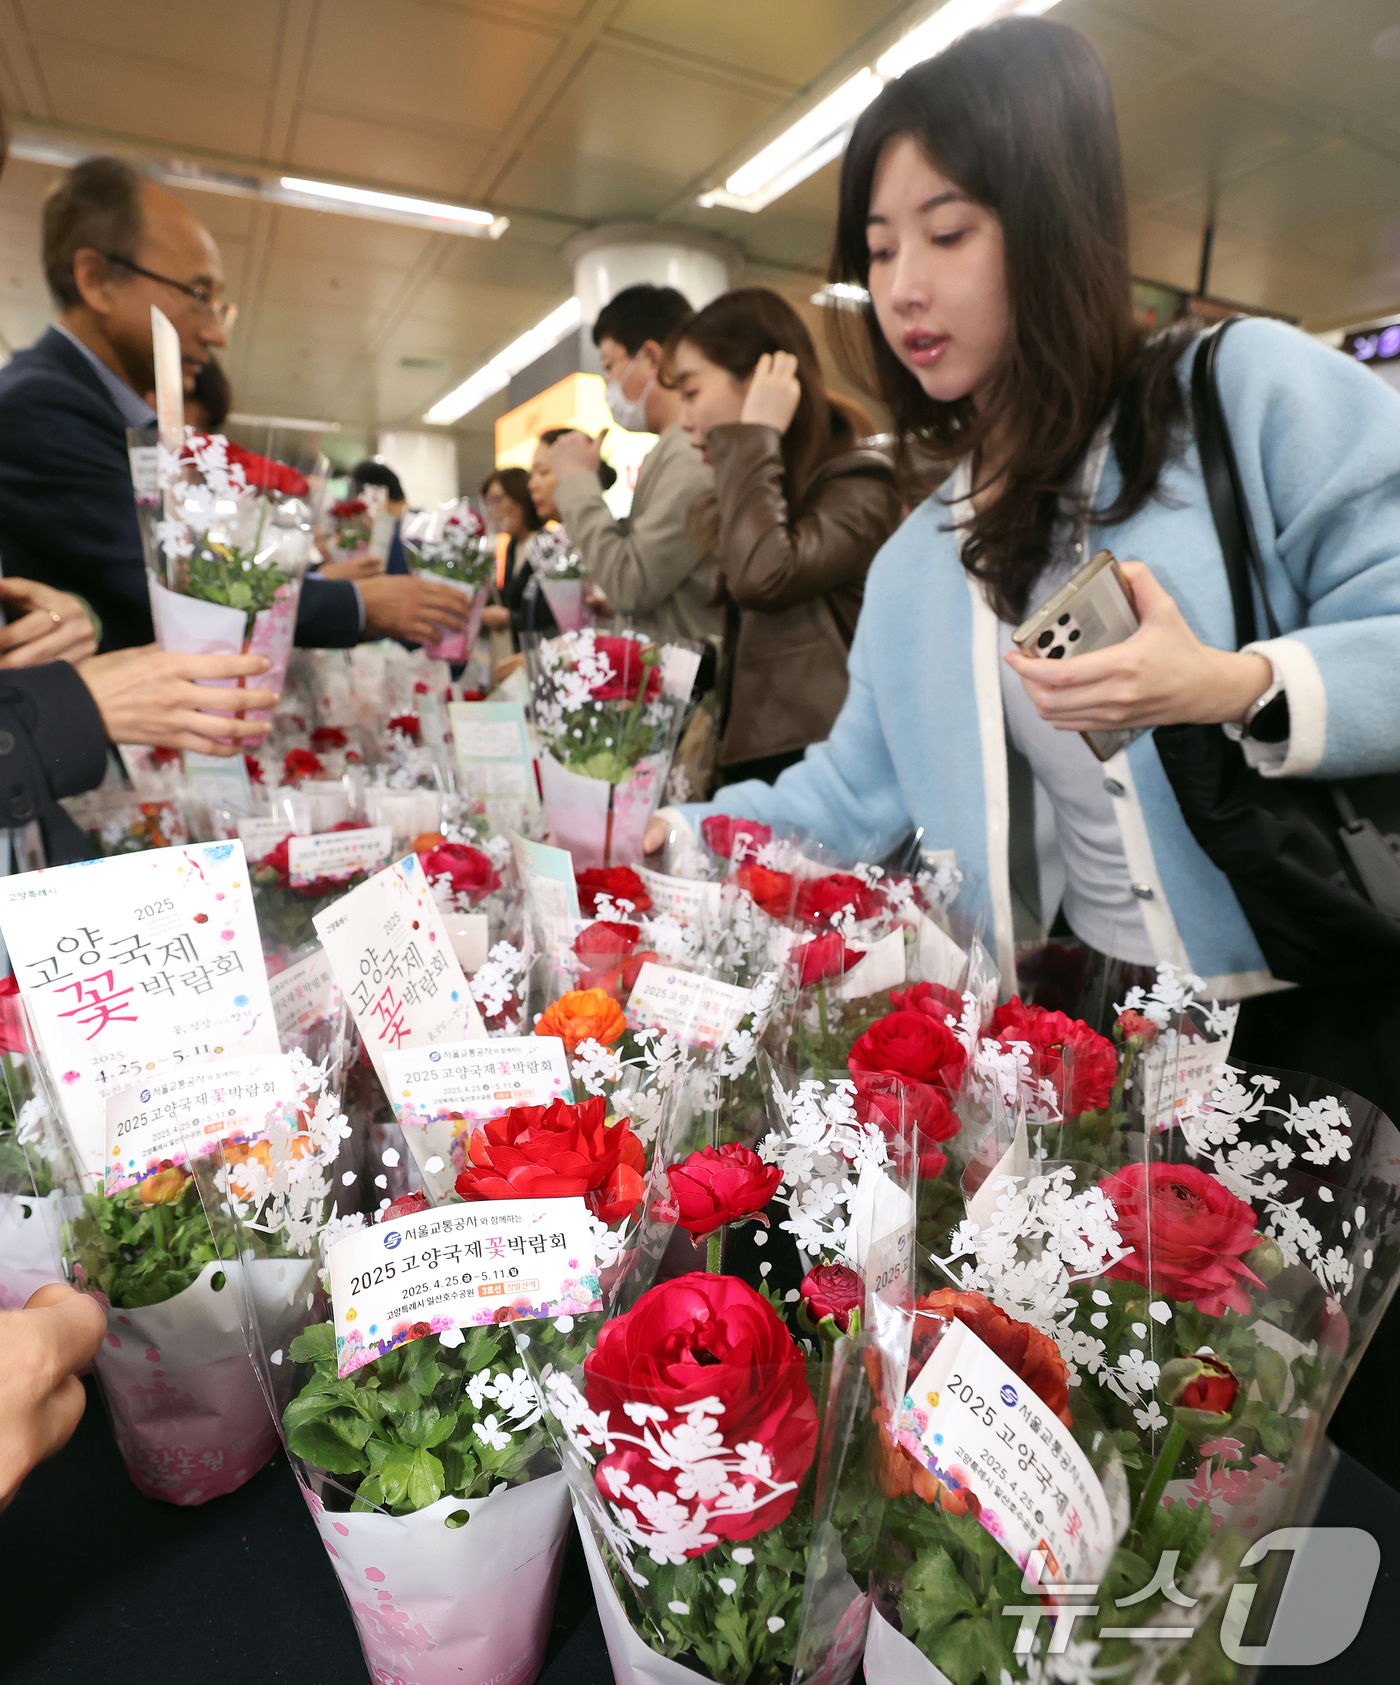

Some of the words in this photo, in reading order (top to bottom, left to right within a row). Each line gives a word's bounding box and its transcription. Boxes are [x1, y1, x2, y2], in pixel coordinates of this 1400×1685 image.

[8, 886, 58, 902] 고양특례시
[133, 897, 175, 922] 2025
[383, 911, 401, 936] 2025
[24, 926, 200, 989] 고양국제
[351, 941, 425, 1016] 고양국제
[53, 950, 245, 1041] 꽃박람회
[370, 949, 449, 1050] 꽃박람회
[404, 1069, 439, 1084] 2025
[441, 1060, 553, 1079] 고양국제꽃박람회
[443, 1046, 492, 1059] 서울교통공사
[152, 1073, 206, 1097] 서울교통공사
[117, 1112, 148, 1138] 2025
[151, 1081, 275, 1122] 고양국제꽃박람회
[405, 1216, 478, 1241] 서울교통공사
[480, 1217, 489, 1226] 와
[490, 1214, 523, 1226] 함께하는
[350, 1261, 396, 1296] 2025
[401, 1232, 567, 1273] 고양국제꽃박람회
[875, 1262, 901, 1293] 2025
[386, 1298, 425, 1321] 고양특례시
[426, 1288, 475, 1307] 일산호수공원
[481, 1283, 503, 1295] 3호선
[506, 1278, 537, 1292] 정발산역
[946, 1374, 998, 1427] 2025
[1018, 1404, 1080, 1486] 서울교통공사
[954, 1445, 995, 1489] 고양특례시
